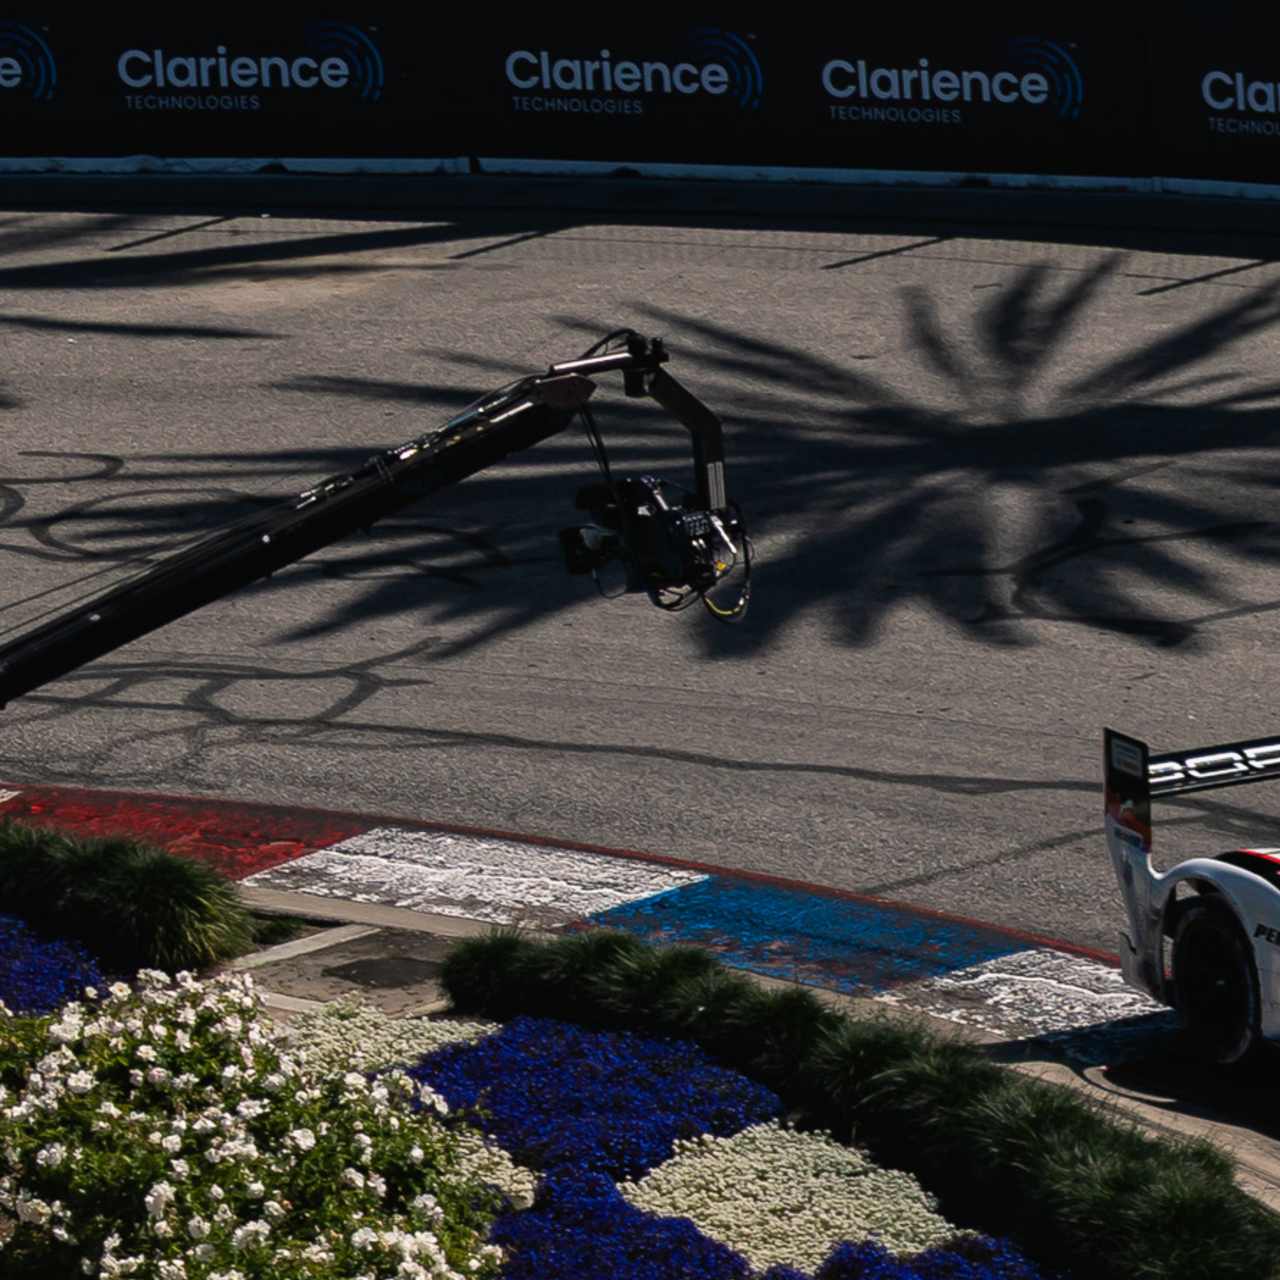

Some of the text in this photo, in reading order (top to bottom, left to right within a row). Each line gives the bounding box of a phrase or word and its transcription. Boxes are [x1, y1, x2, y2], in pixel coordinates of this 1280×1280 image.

[117, 45, 350, 88] Clarience
[505, 49, 729, 96] Clarience
[821, 58, 1049, 104] Clarience
[126, 95, 261, 112] TECHNOLOGIES
[512, 97, 643, 115] TECHNOLOGIES
[828, 106, 961, 125] TECHNOLOGIES
